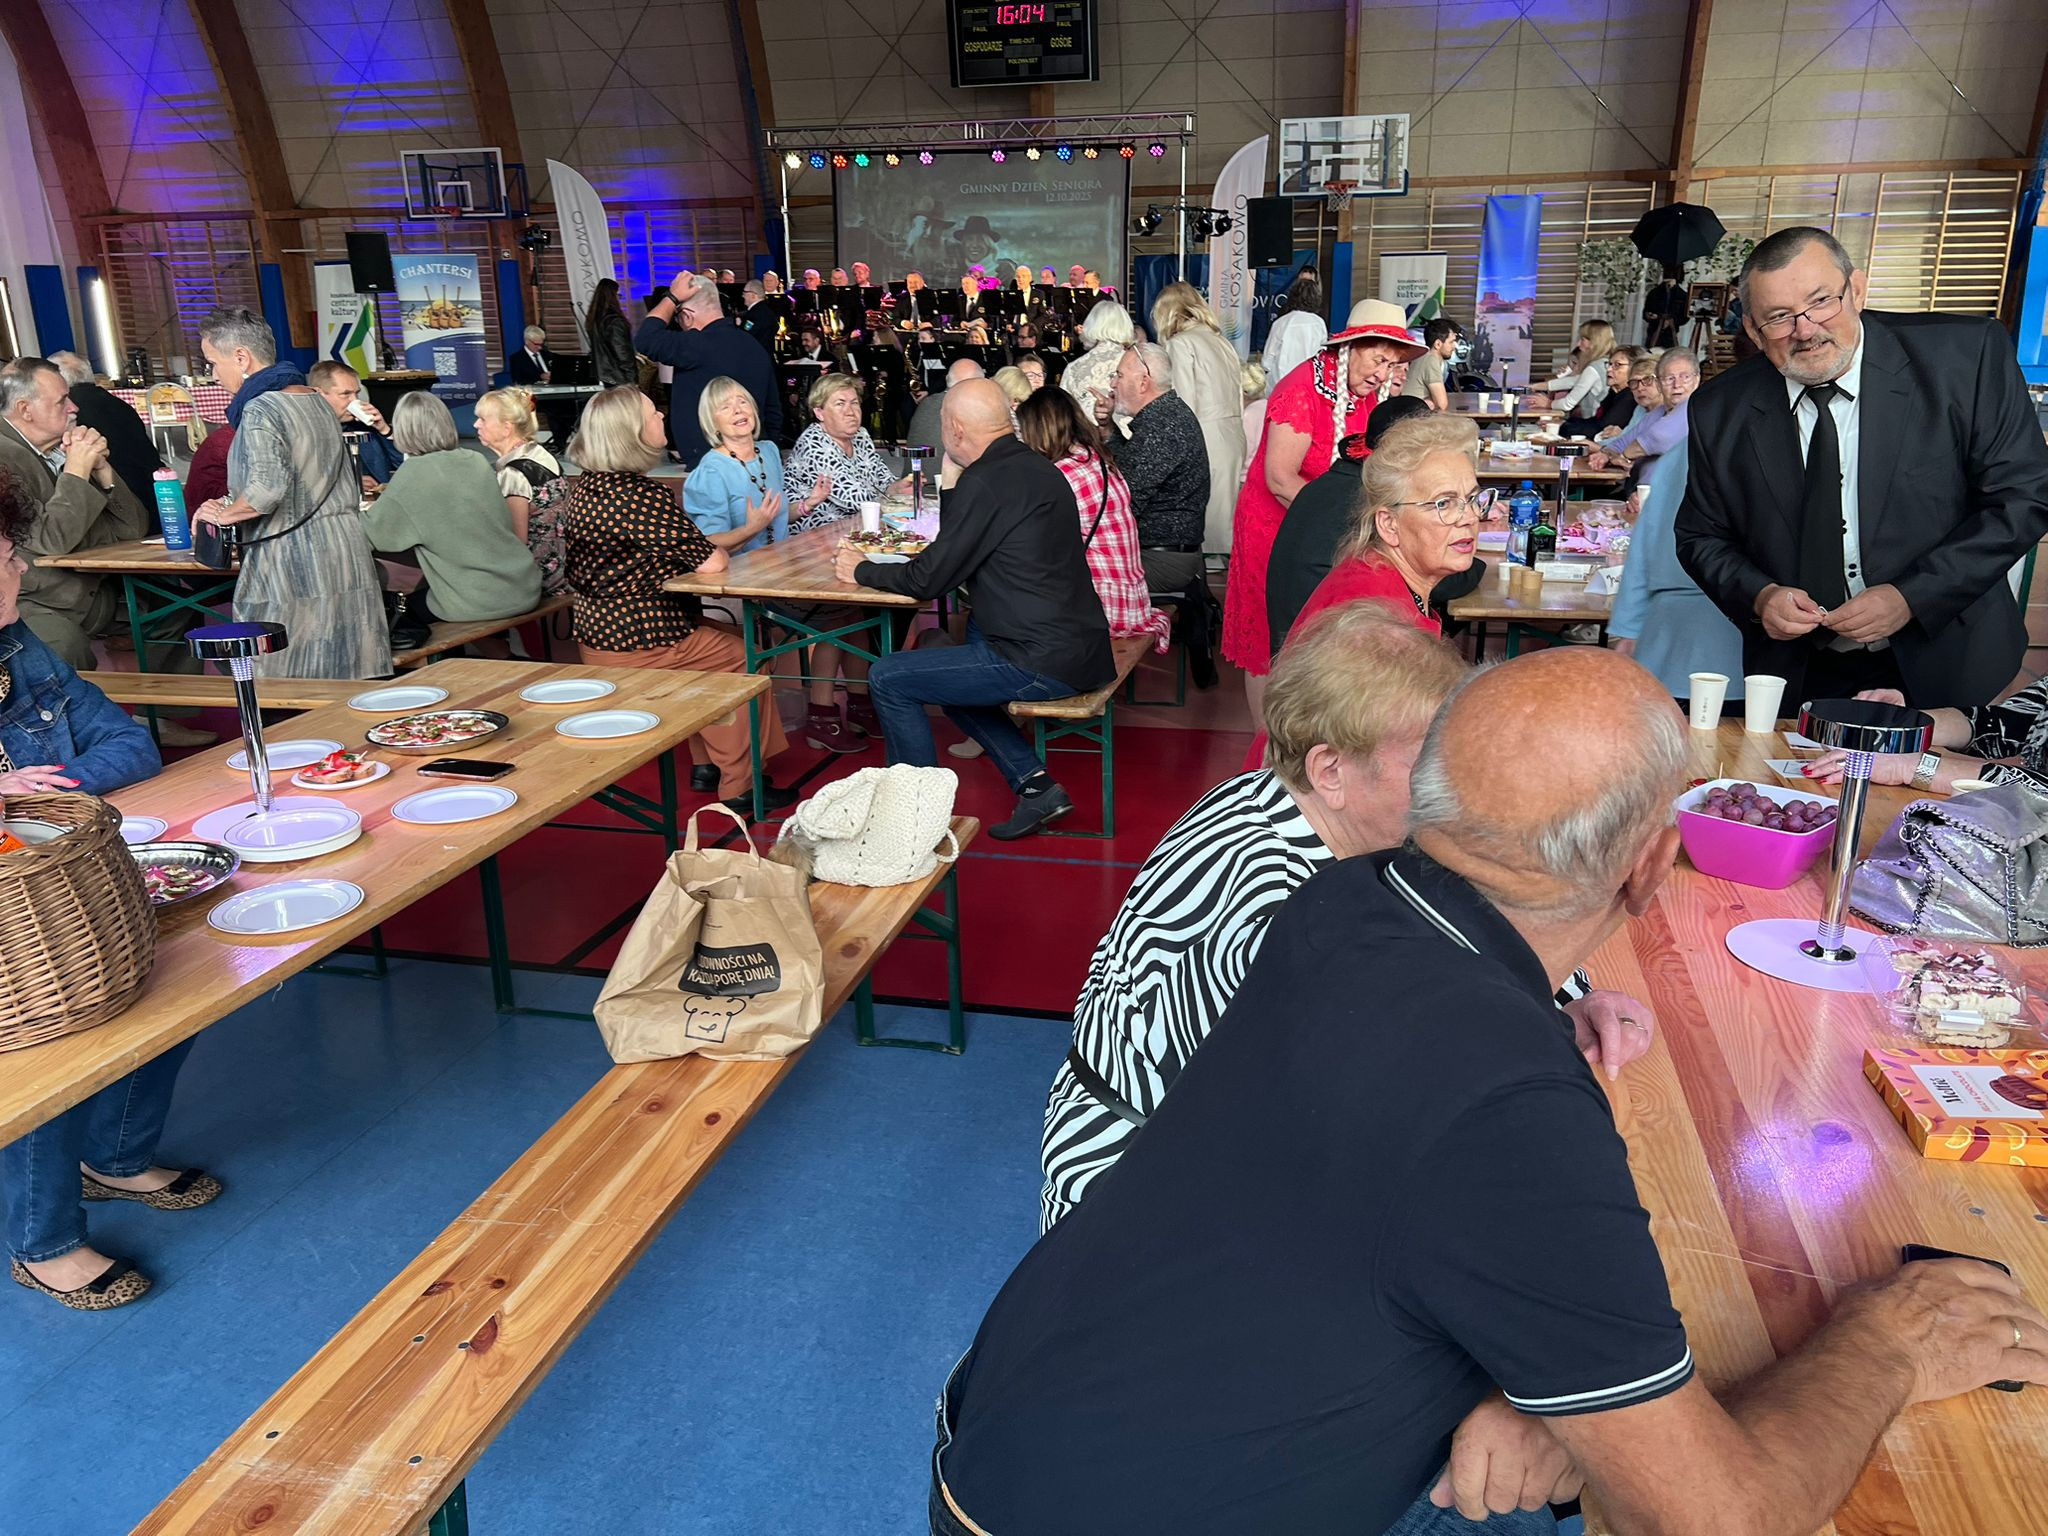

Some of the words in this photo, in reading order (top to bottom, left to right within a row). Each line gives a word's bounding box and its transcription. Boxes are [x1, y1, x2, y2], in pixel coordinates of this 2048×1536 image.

[997, 4, 1045, 25] 16:04
[964, 41, 1003, 52] GOSPODARZE
[960, 183, 1008, 194] GMINNY
[1051, 179, 1102, 191] SENIORA
[1230, 194, 1248, 308] KOSAKOWO
[400, 263, 473, 279] CHANTERSI
[1396, 290, 1428, 299] kultury
[747, 952, 767, 965] NA
[714, 971, 746, 986] PORĘ
[743, 965, 776, 982] DNIA!
